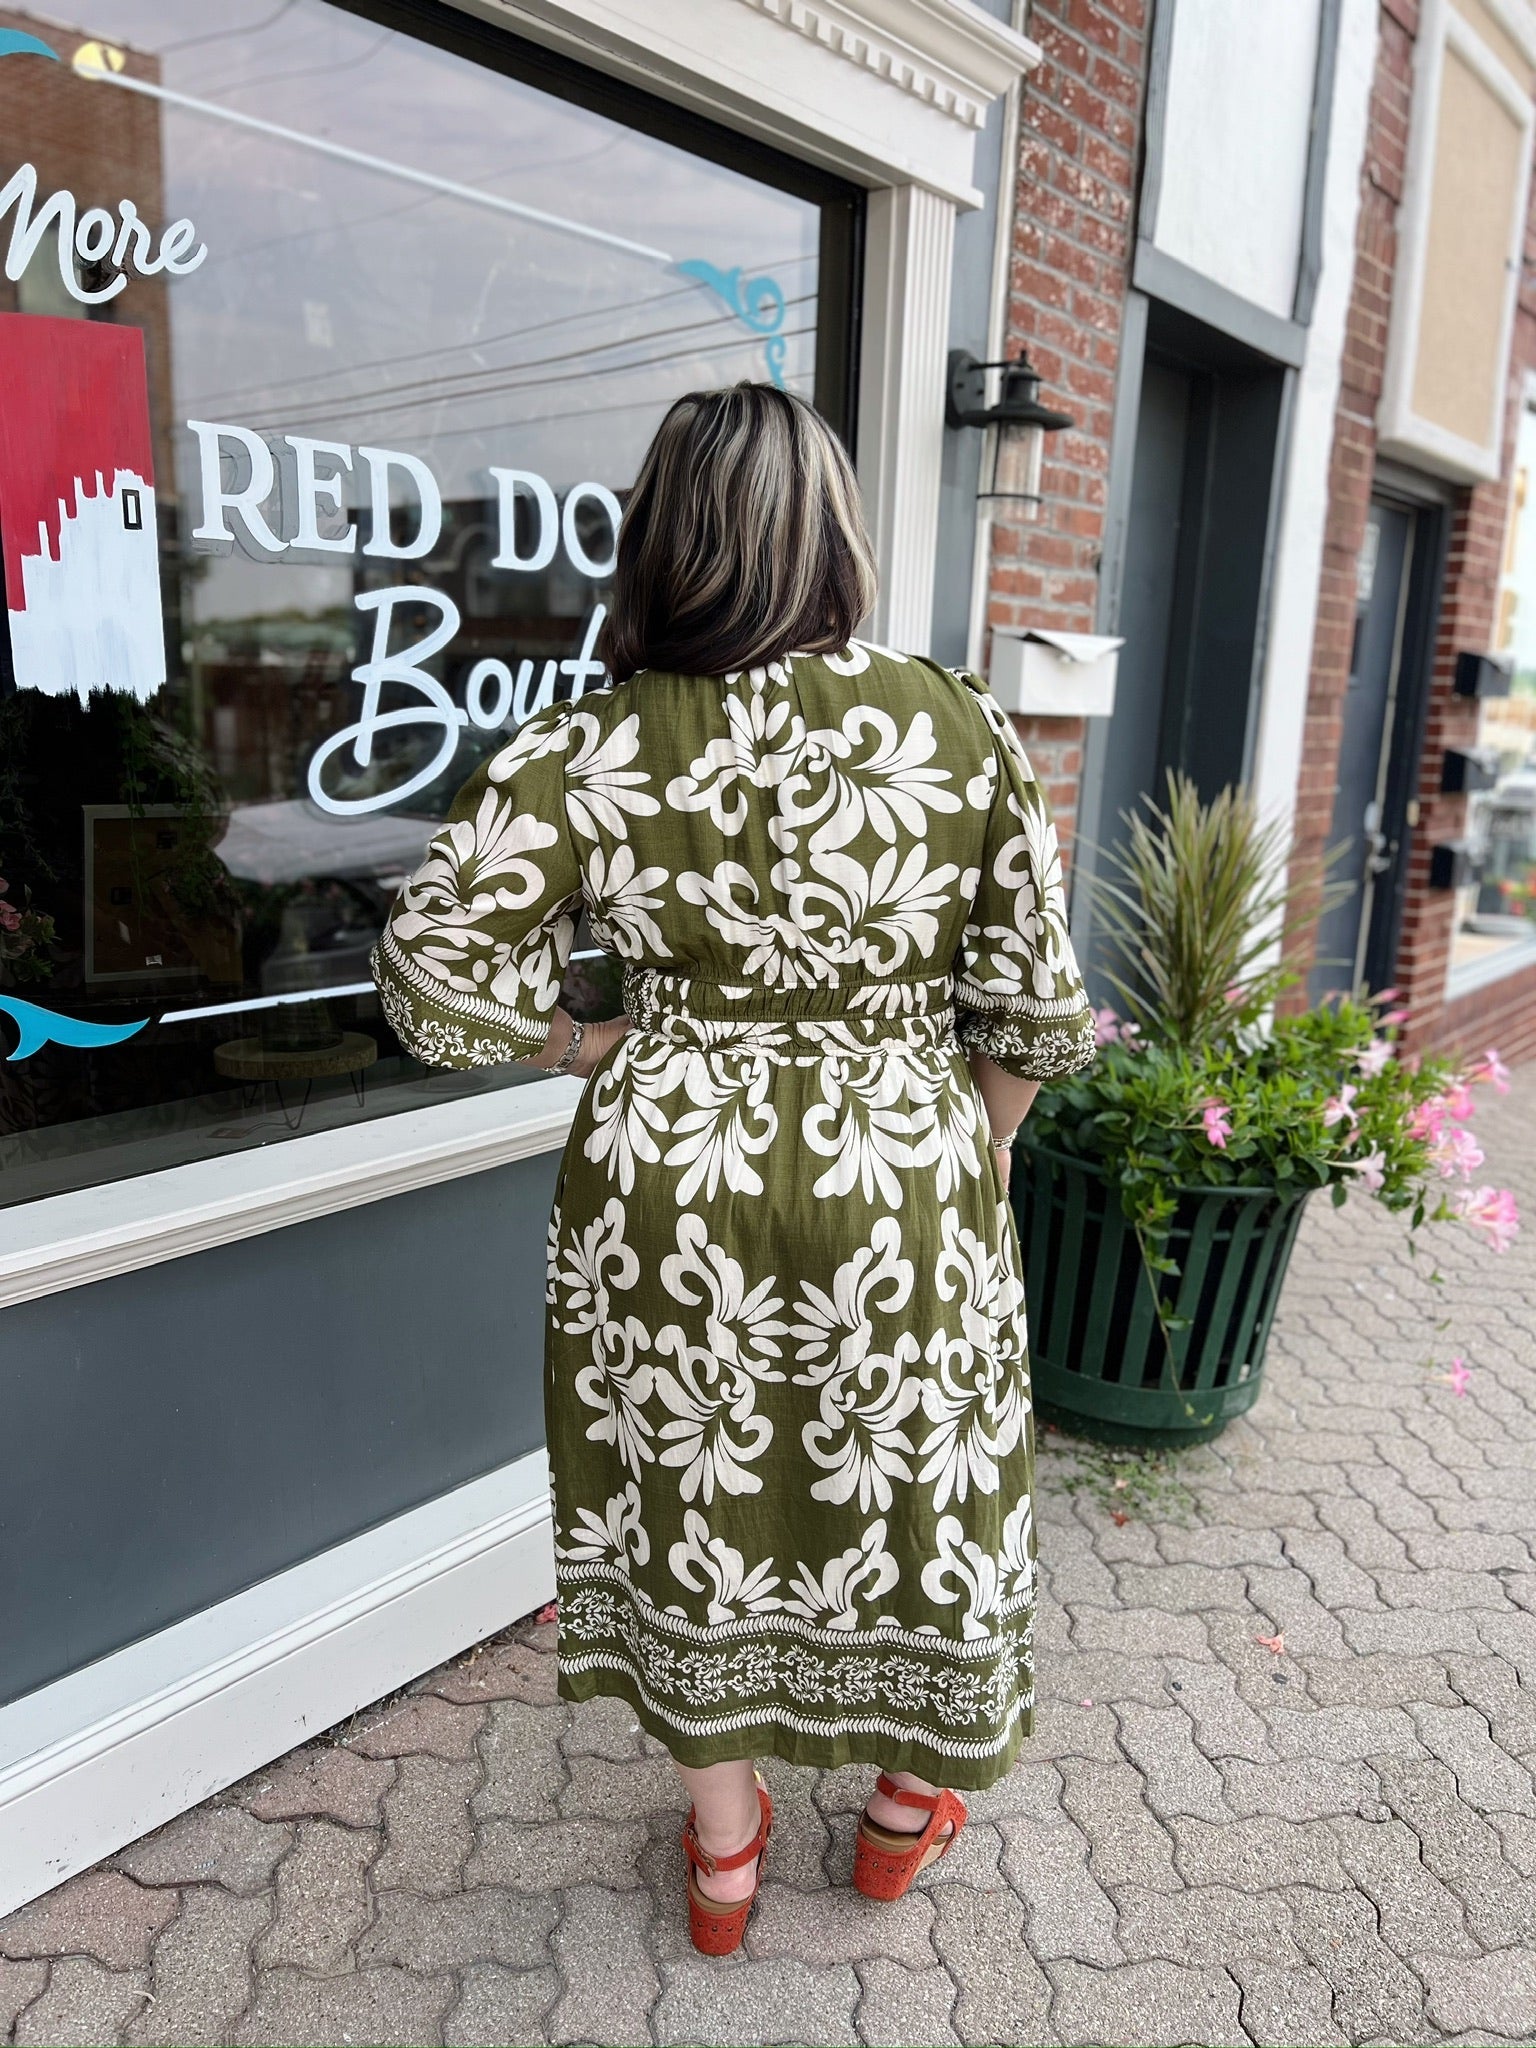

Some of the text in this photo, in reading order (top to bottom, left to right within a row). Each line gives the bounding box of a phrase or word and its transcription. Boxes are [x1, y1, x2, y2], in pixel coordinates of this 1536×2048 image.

[0, 163, 208, 304] More
[187, 419, 623, 578] RED DO
